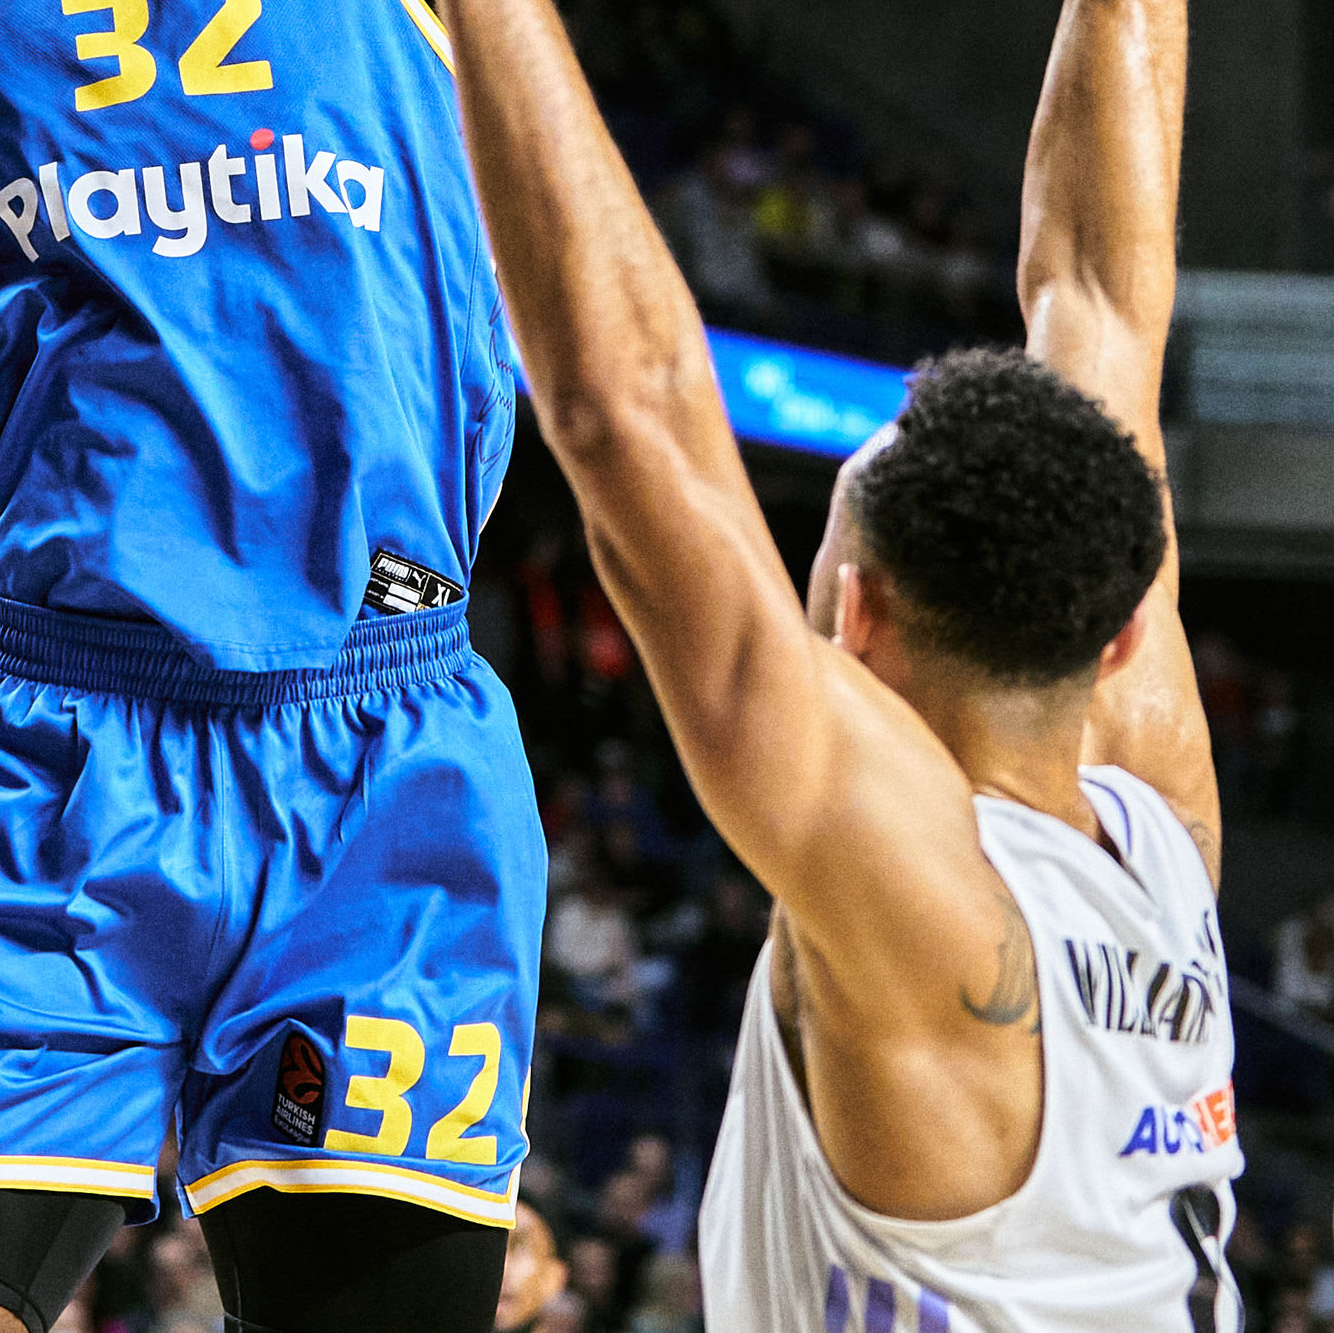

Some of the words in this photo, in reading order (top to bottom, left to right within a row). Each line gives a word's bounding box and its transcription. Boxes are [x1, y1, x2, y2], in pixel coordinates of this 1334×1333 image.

[324, 1014, 501, 1165] 32
[276, 1105, 314, 1135] AIRLINES
[278, 1092, 316, 1125] TURKISH
